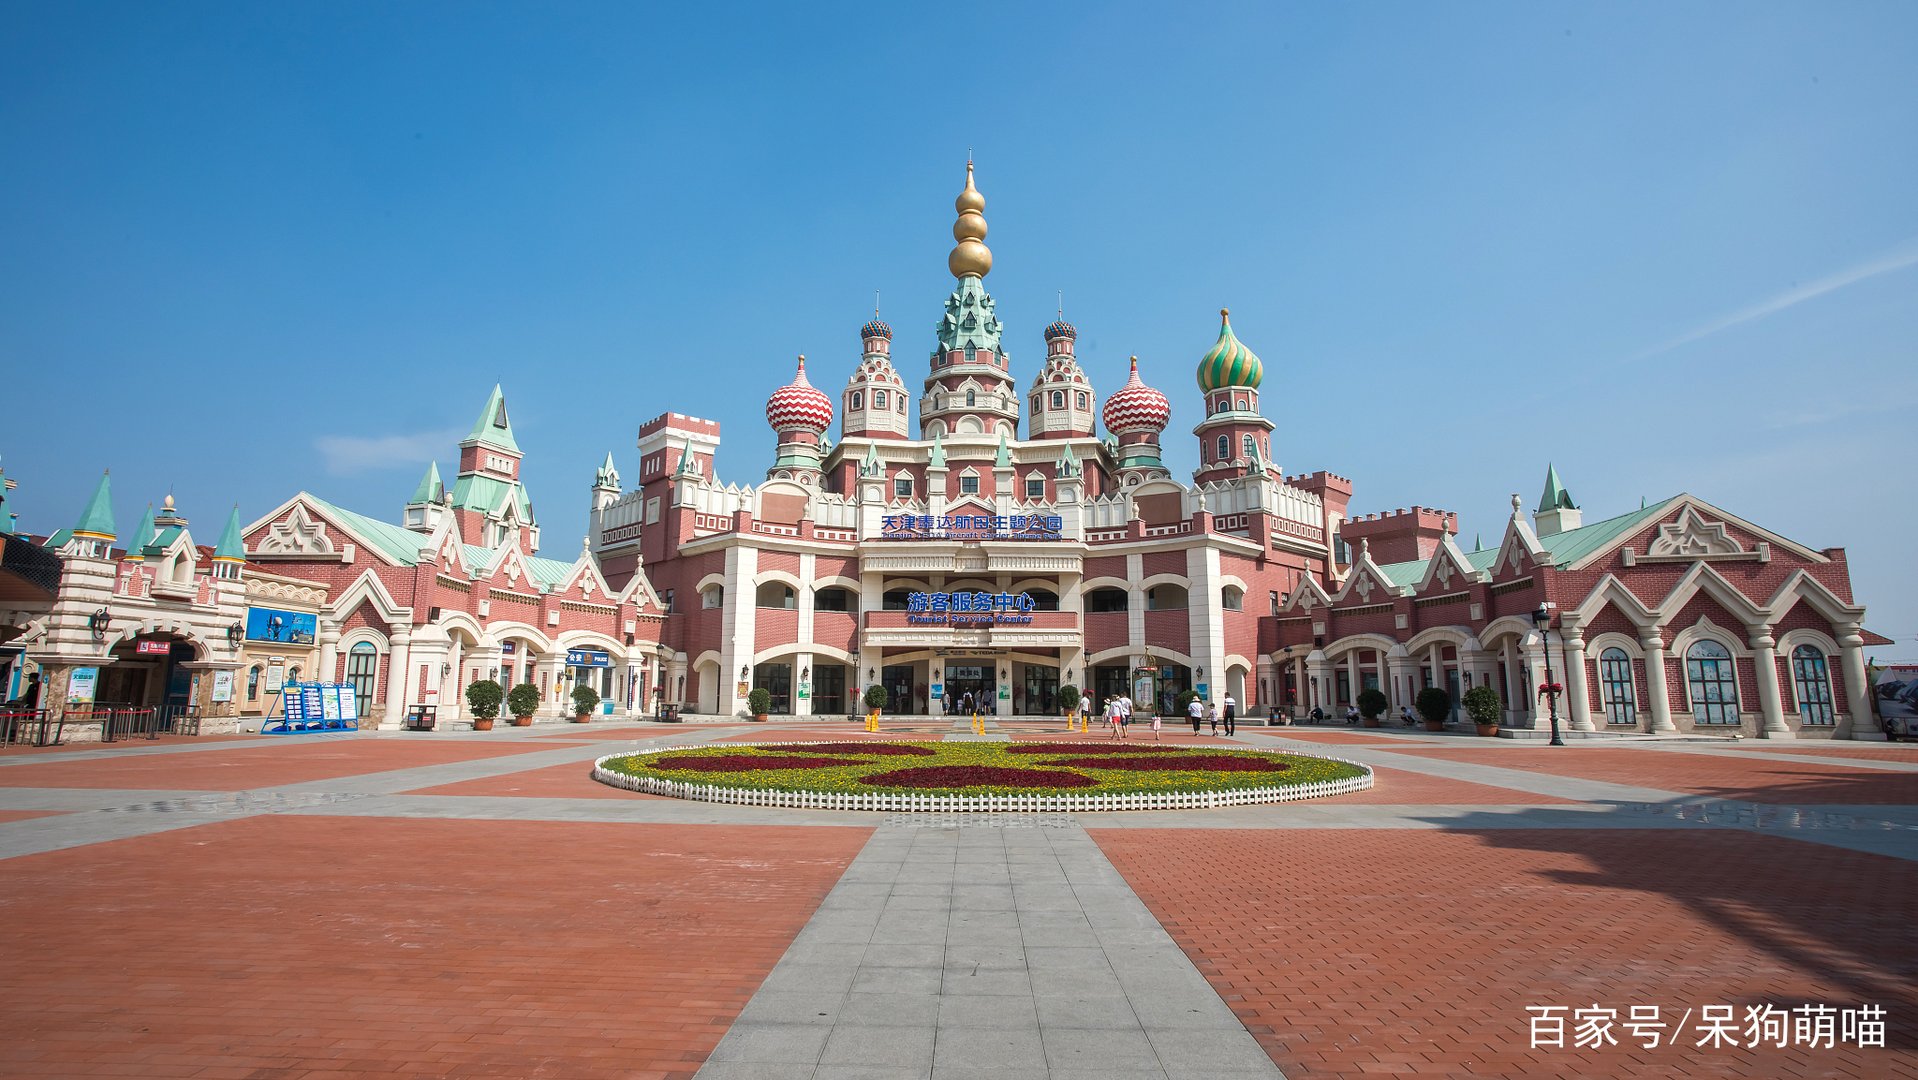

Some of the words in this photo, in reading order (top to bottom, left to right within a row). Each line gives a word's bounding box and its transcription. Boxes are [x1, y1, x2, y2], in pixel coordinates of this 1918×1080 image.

[881, 515, 1063, 530] 天津泰达航母主题公园
[882, 532, 912, 540] Tianjin
[1012, 532, 1041, 540] Theme
[1043, 532, 1063, 540] Park
[907, 592, 1035, 612] 游客服务中心
[909, 614, 949, 624] Tourist
[951, 614, 994, 623] Service
[996, 614, 1033, 624] Center
[569, 654, 582, 662] 公安
